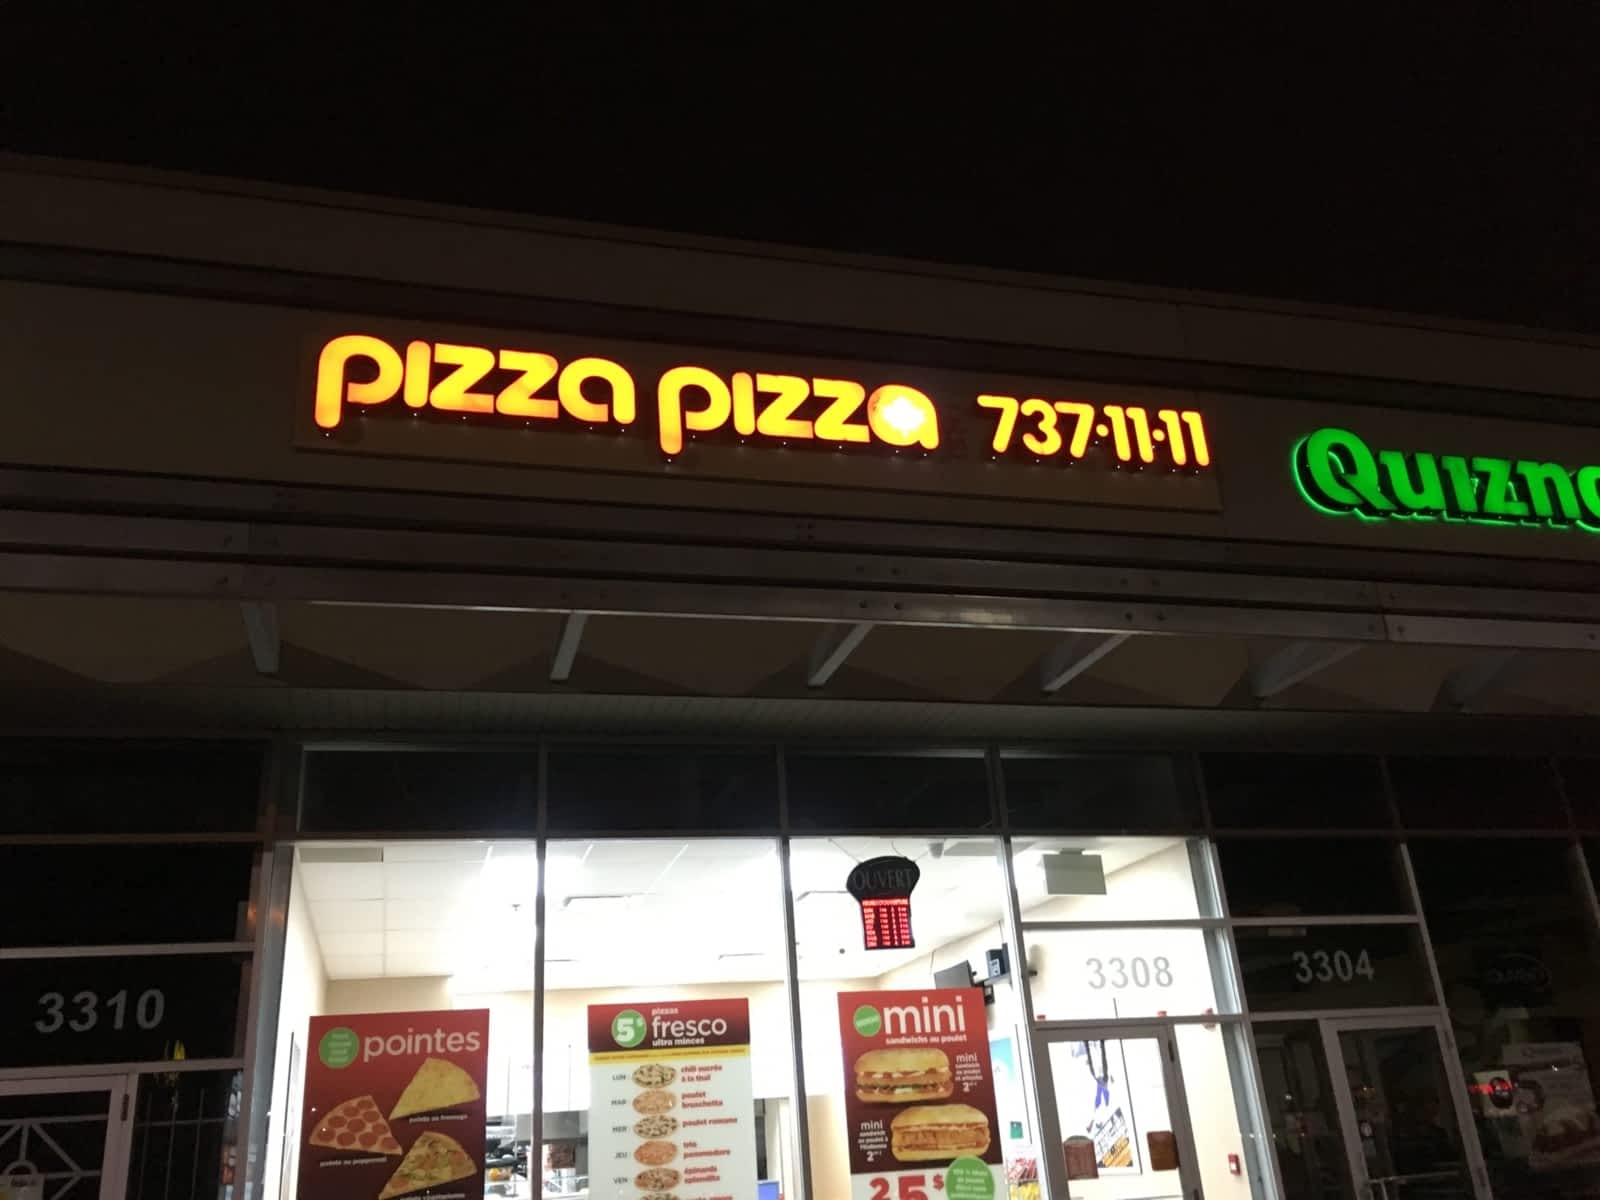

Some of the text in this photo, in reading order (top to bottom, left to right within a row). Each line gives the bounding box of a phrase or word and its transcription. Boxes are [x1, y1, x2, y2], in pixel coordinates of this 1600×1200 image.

[315, 335, 939, 455] pizza pizza
[853, 868, 912, 889] OUVERT
[1085, 956, 1173, 990] 3308
[1292, 949, 1374, 984] 3304
[35, 989, 165, 1033] 3310
[651, 1015, 727, 1038] fresco
[883, 995, 966, 1034] mini
[363, 1028, 480, 1063] pointes
